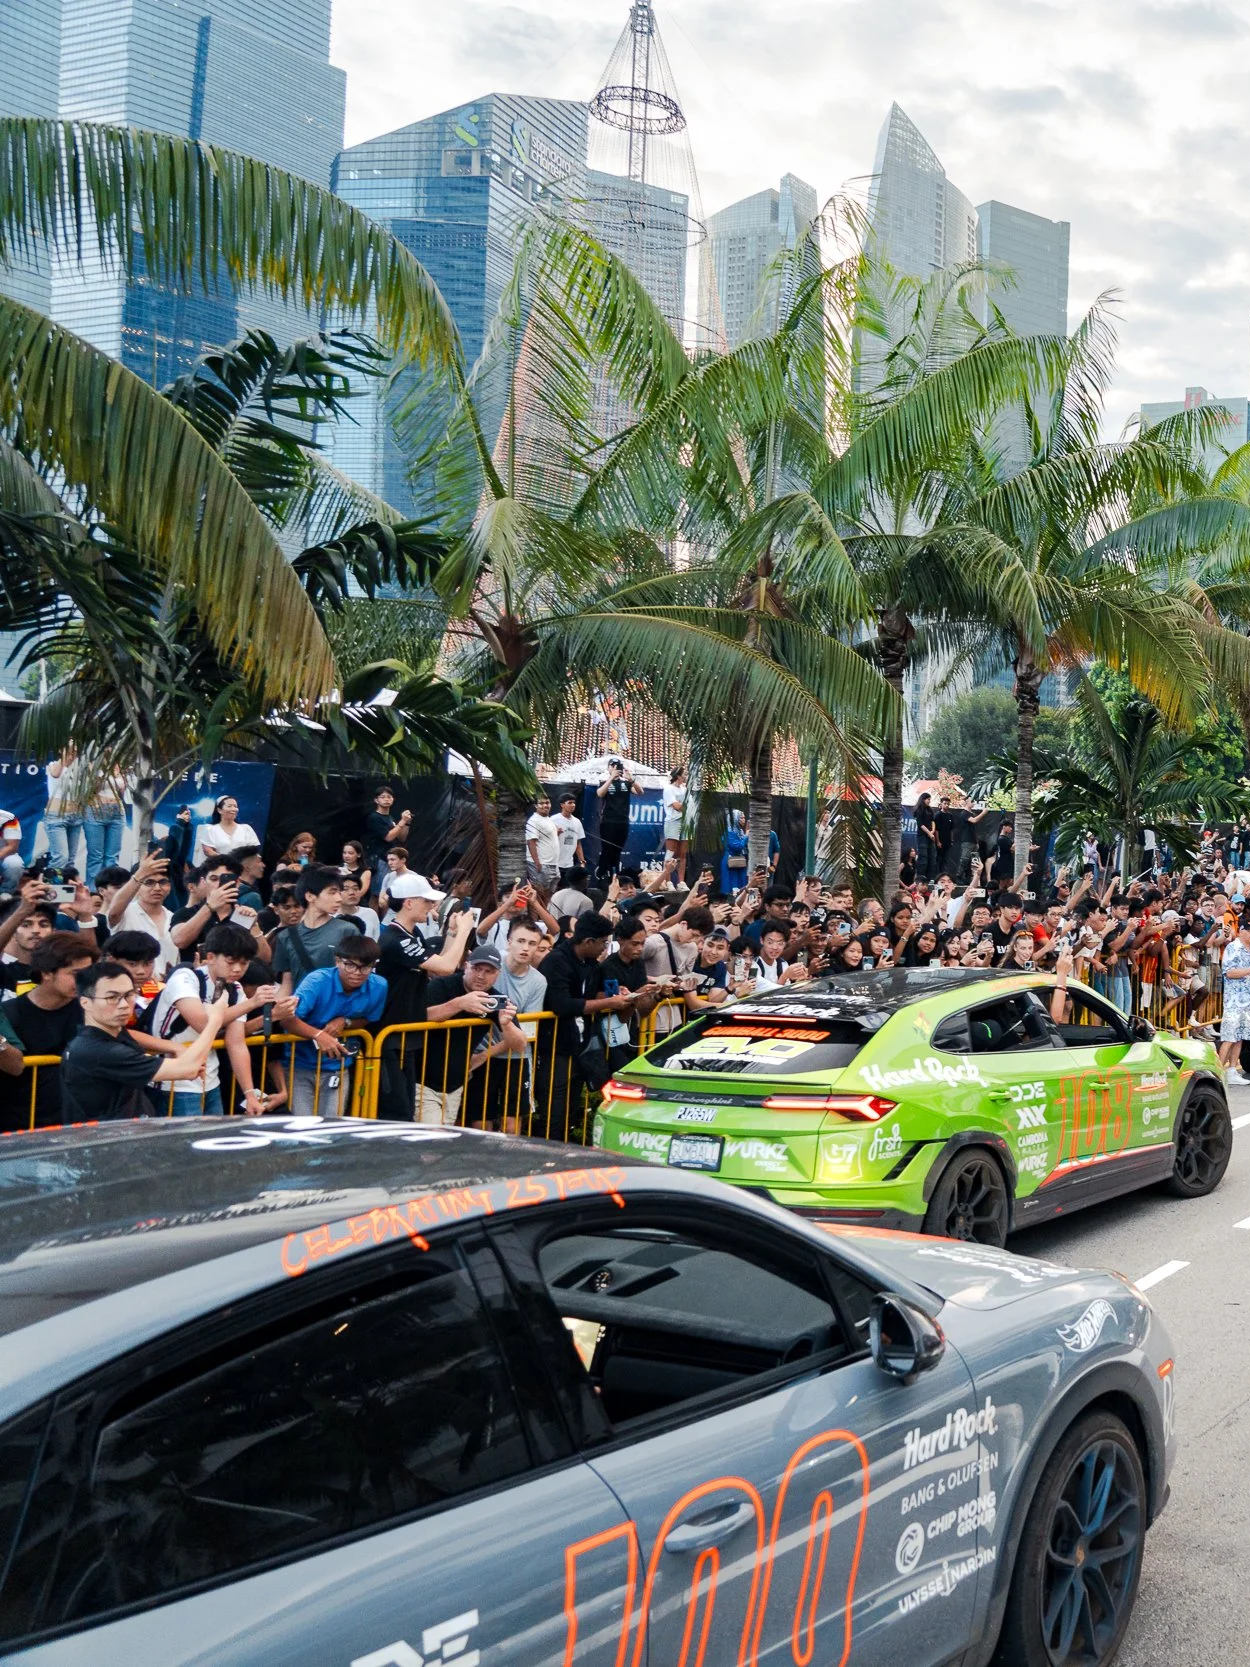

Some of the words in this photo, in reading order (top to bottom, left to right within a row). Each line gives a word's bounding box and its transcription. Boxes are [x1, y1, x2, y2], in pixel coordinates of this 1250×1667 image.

[718, 1003, 782, 1015] Hard
[780, 1003, 841, 1019] Rock
[702, 1026, 780, 1038] GUMBALL
[774, 1028, 831, 1041] 3000
[859, 1057, 923, 1091] Hard
[923, 1056, 989, 1088] Rock
[1057, 1065, 1133, 1166] 108
[618, 1131, 671, 1151] WURKZ
[724, 1139, 789, 1161] WURKZ
[868, 1123, 903, 1162] frsh
[1018, 1152, 1048, 1173] WURKZ
[281, 1187, 494, 1277] CELEBRATING
[507, 1175, 548, 1210] 25
[547, 1165, 628, 1209] YEARS
[903, 1411, 954, 1471] Hard
[952, 1395, 998, 1449] Rock
[901, 1483, 935, 1516] BANG
[936, 1477, 946, 1496] &
[947, 1451, 999, 1491] OLUFSEN
[926, 1509, 957, 1540] CHIP
[957, 1490, 997, 1519] MONG
[956, 1508, 997, 1538] GROUP
[898, 1575, 945, 1615] ULYSSE
[949, 1545, 997, 1583] NARDIN
